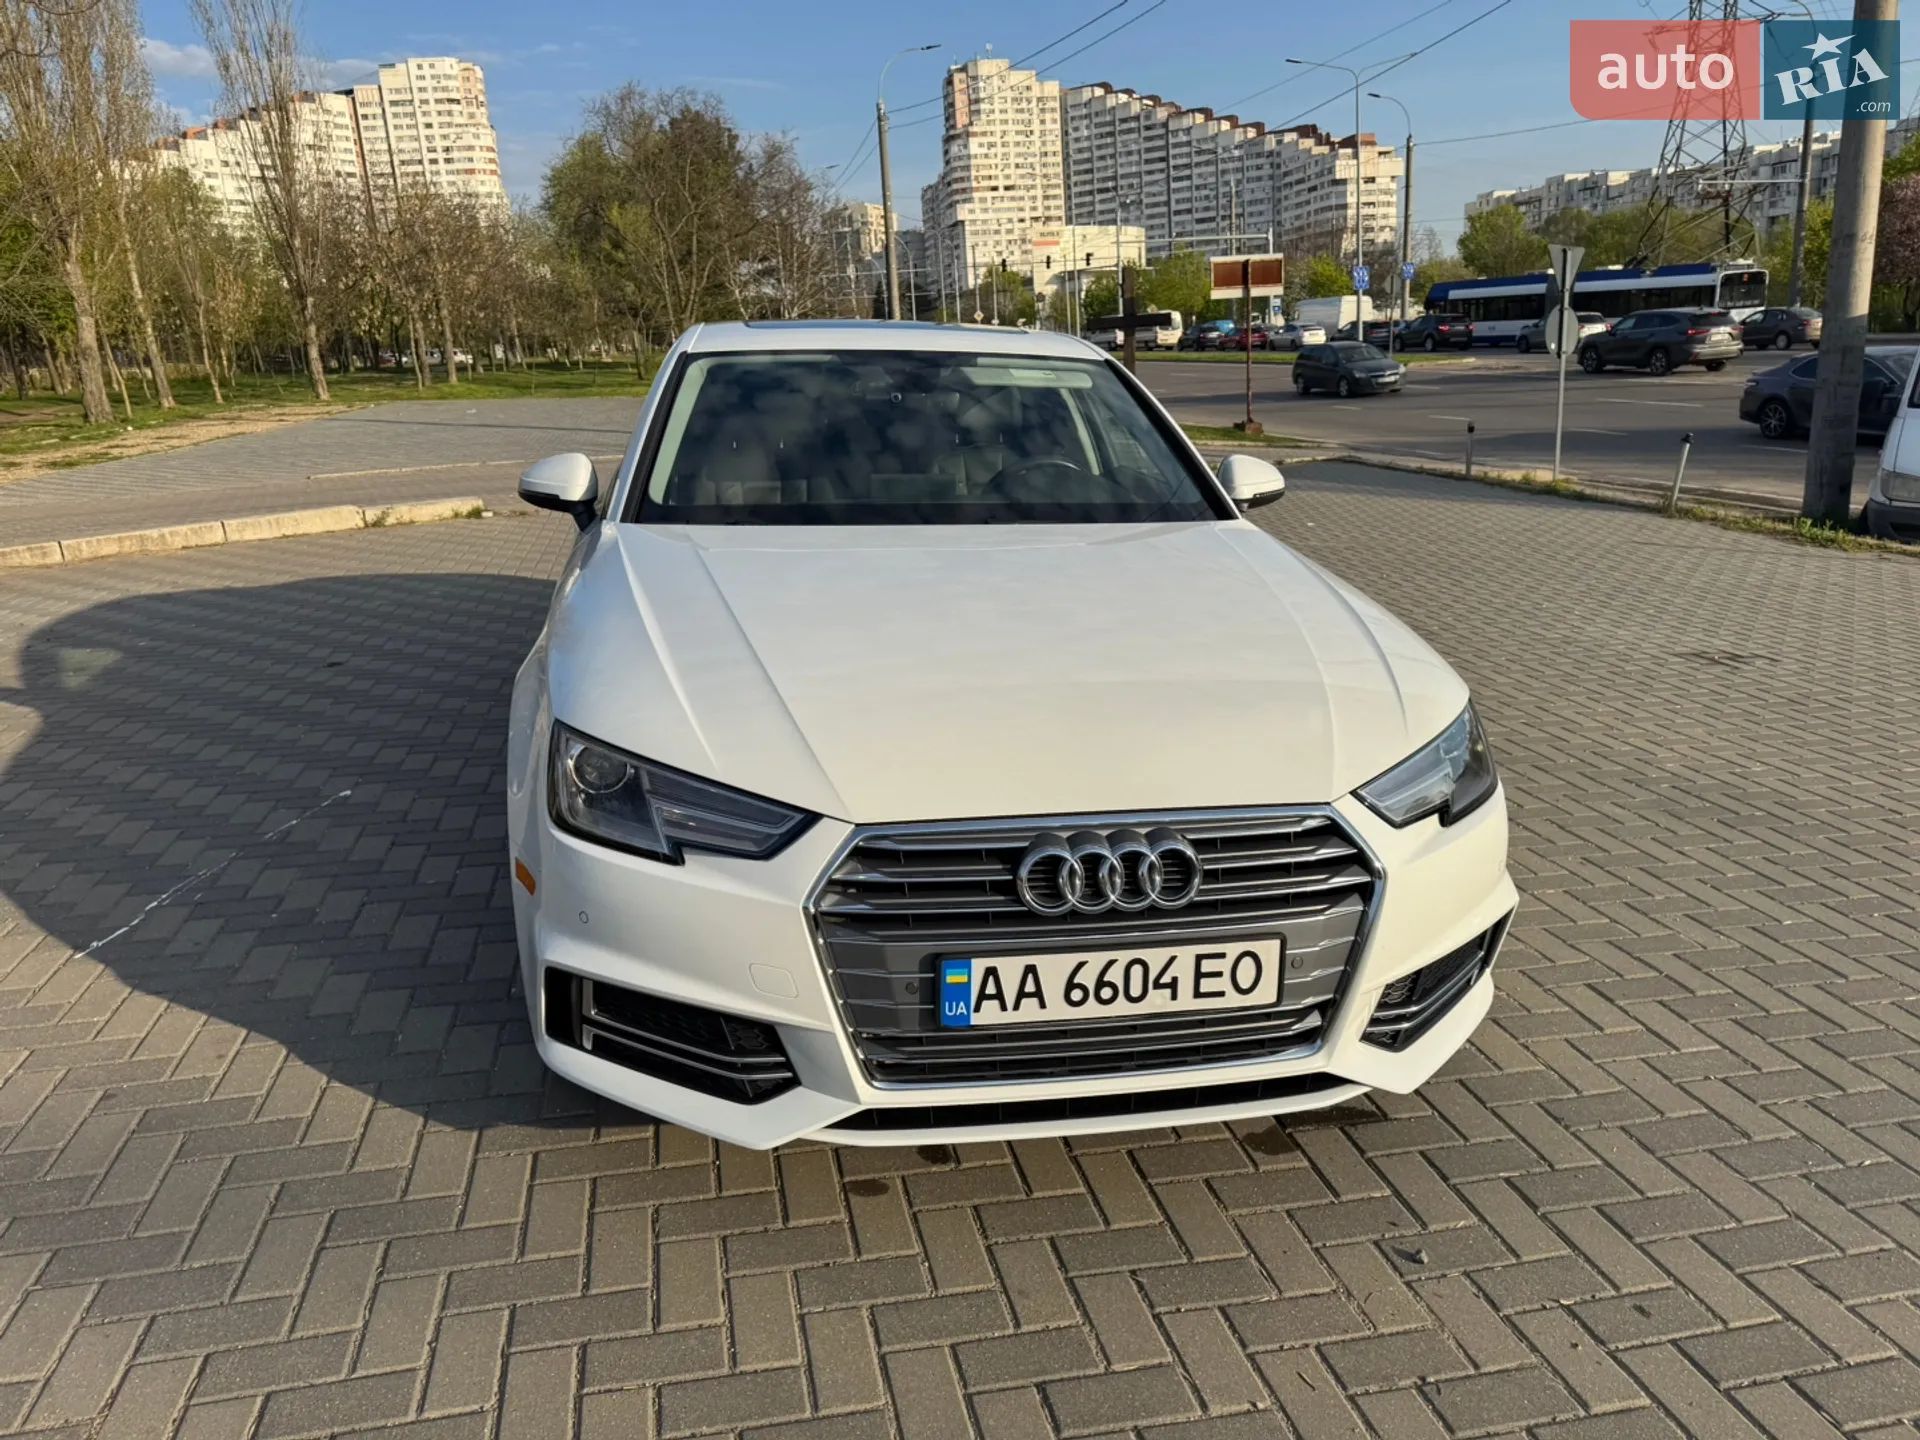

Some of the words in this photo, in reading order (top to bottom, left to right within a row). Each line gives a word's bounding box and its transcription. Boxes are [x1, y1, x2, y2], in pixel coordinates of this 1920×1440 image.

[972, 963, 1047, 1013] AA
[1063, 954, 1179, 1008] 6604
[1192, 949, 1263, 999] EO
[945, 1002, 967, 1016] UA
